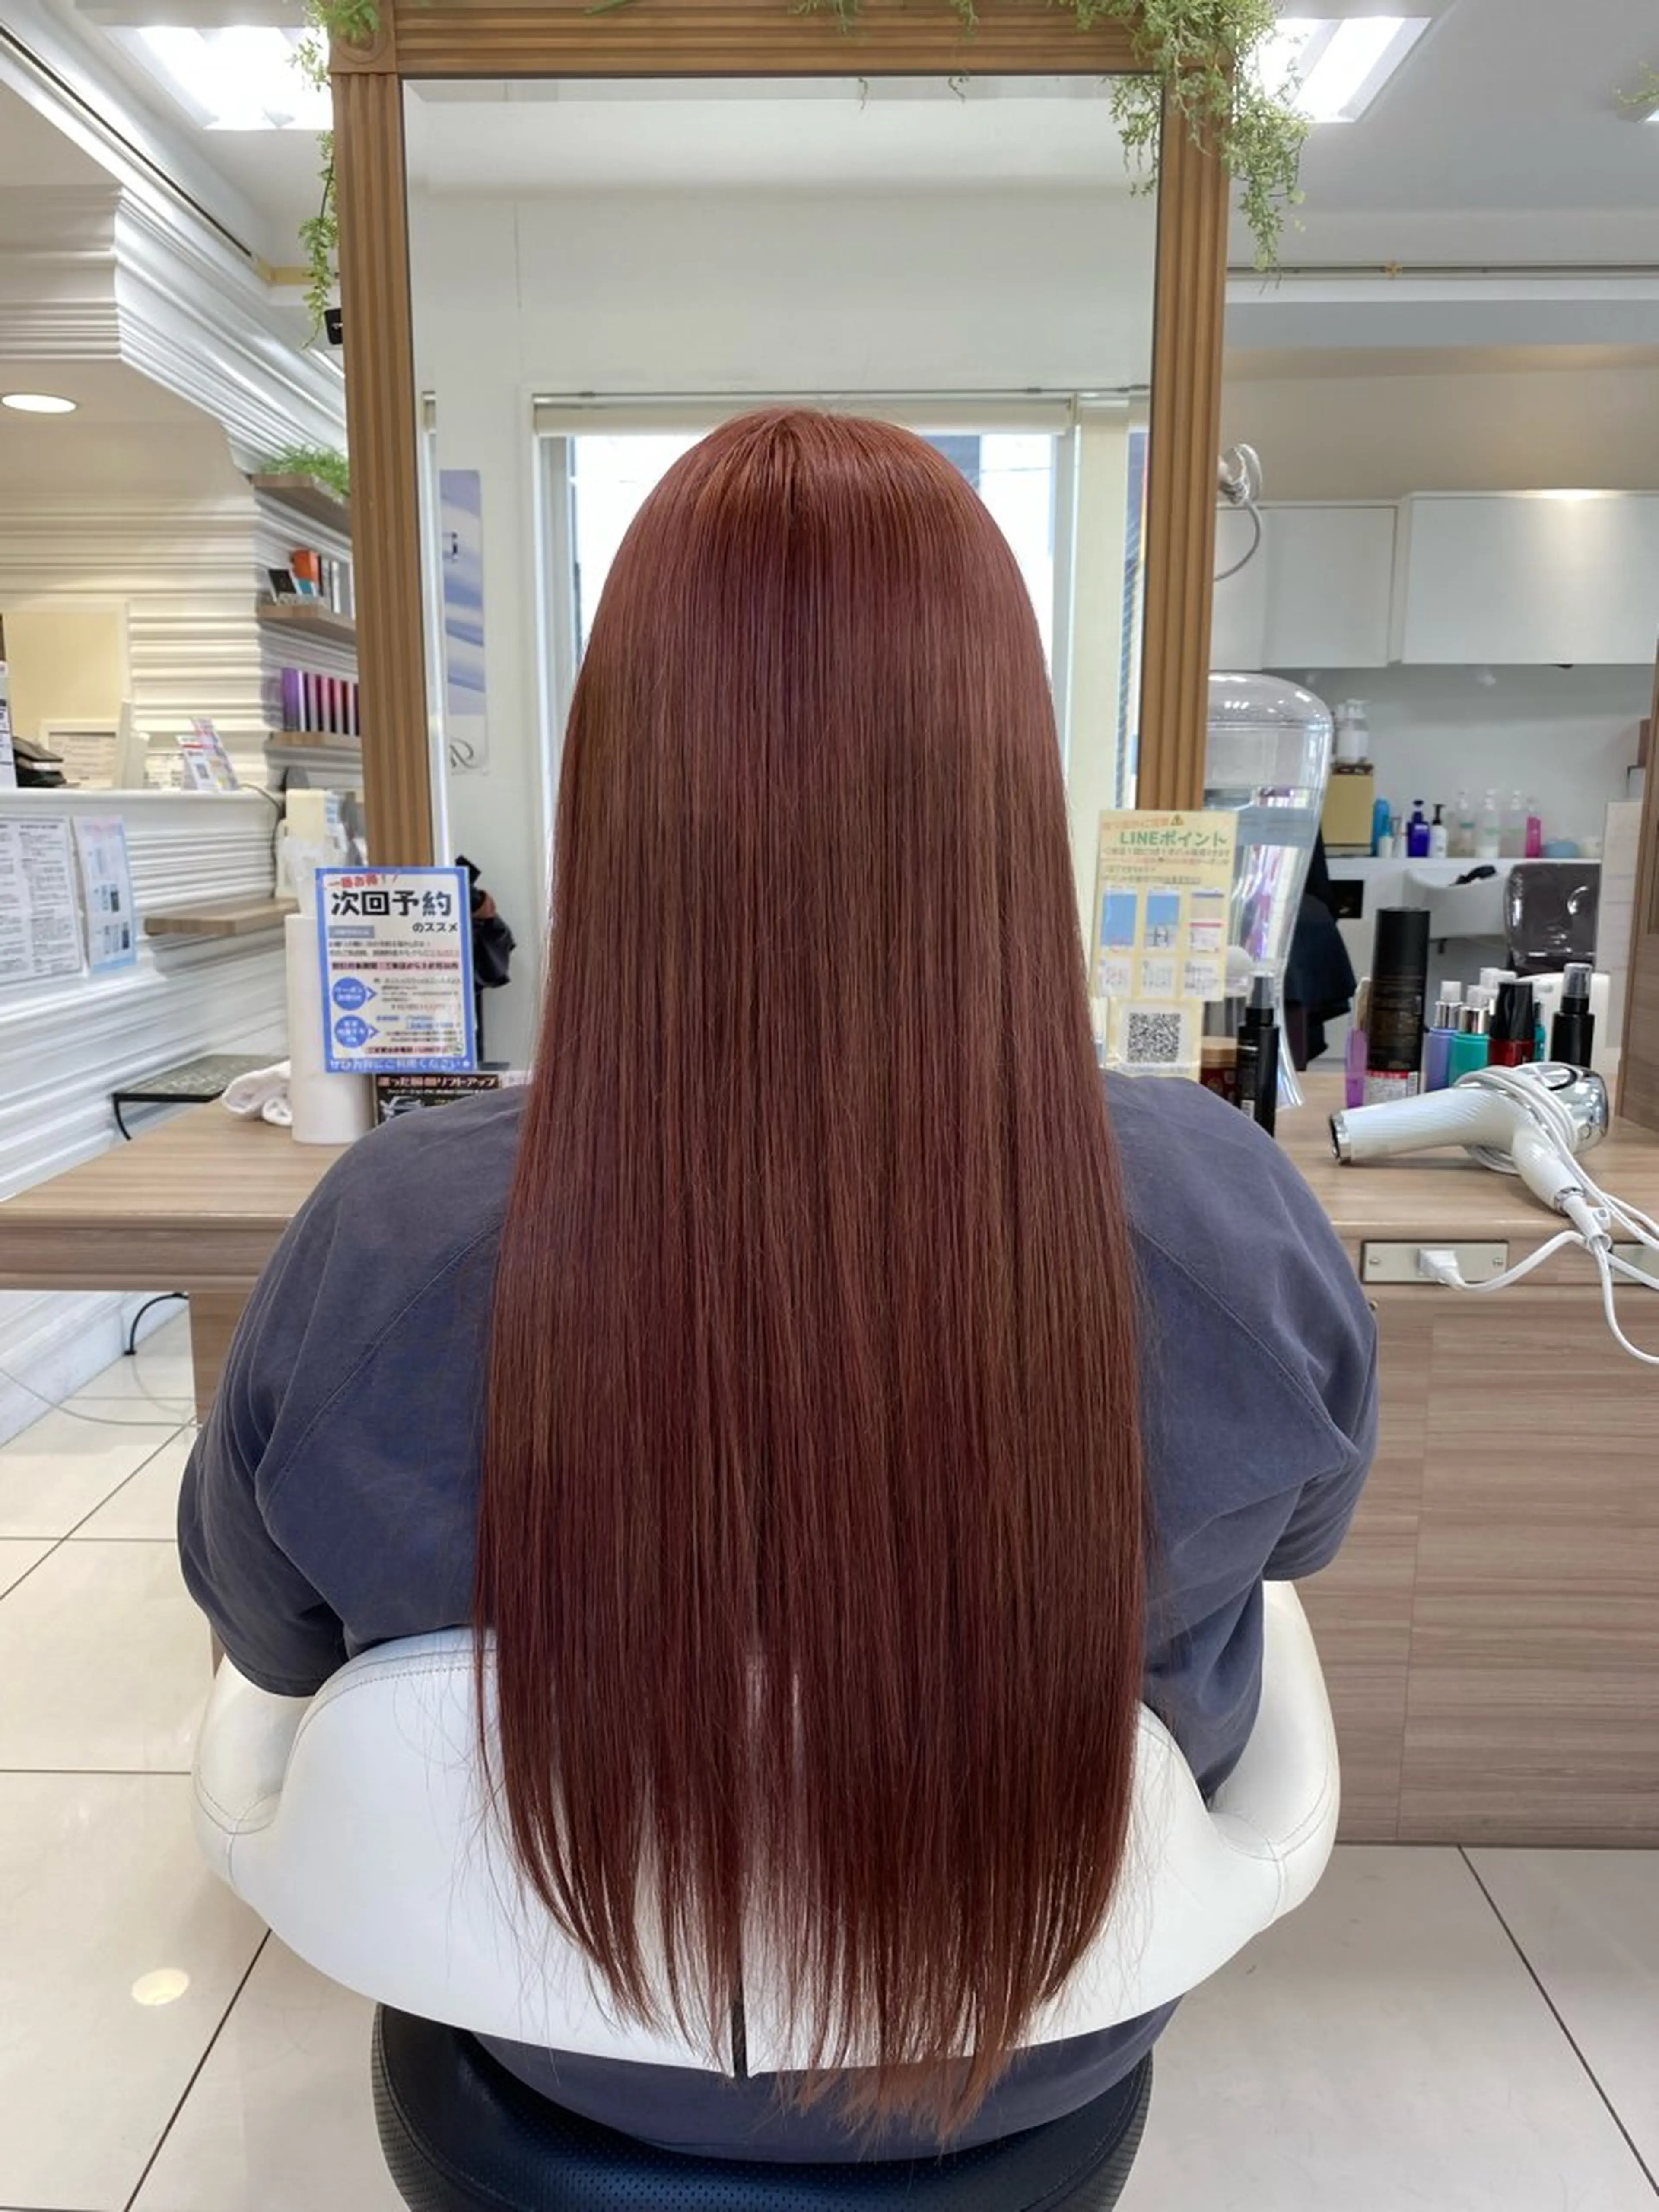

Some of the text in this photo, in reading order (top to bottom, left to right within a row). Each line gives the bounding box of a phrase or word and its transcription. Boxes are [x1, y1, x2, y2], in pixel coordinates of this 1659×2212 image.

[1120, 830, 1227, 847] LINEポイント
[331, 890, 451, 916] 次回予約
[412, 922, 458, 932] のススメ
